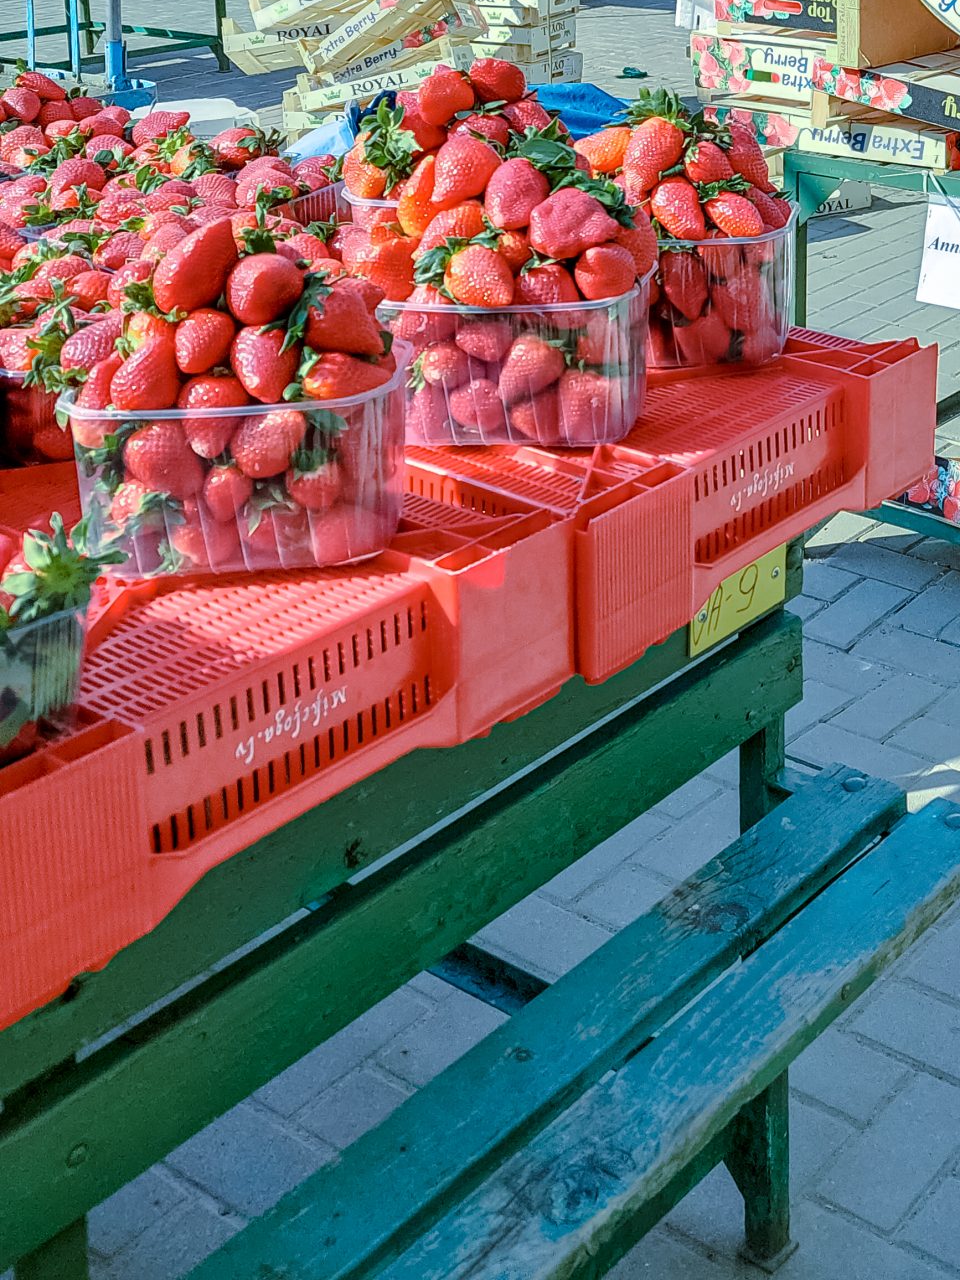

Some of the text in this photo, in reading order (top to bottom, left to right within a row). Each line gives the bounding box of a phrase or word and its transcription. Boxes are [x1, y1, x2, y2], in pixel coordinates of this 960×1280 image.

[808, 5, 834, 24] Top
[321, 11, 379, 59] xtra Berry
[364, 46, 401, 70] Berry
[764, 47, 808, 74] Berry
[350, 73, 409, 96] ROYAL
[781, 73, 814, 90] xtra
[871, 135, 925, 161] Extra
[814, 198, 854, 215] OYAL
